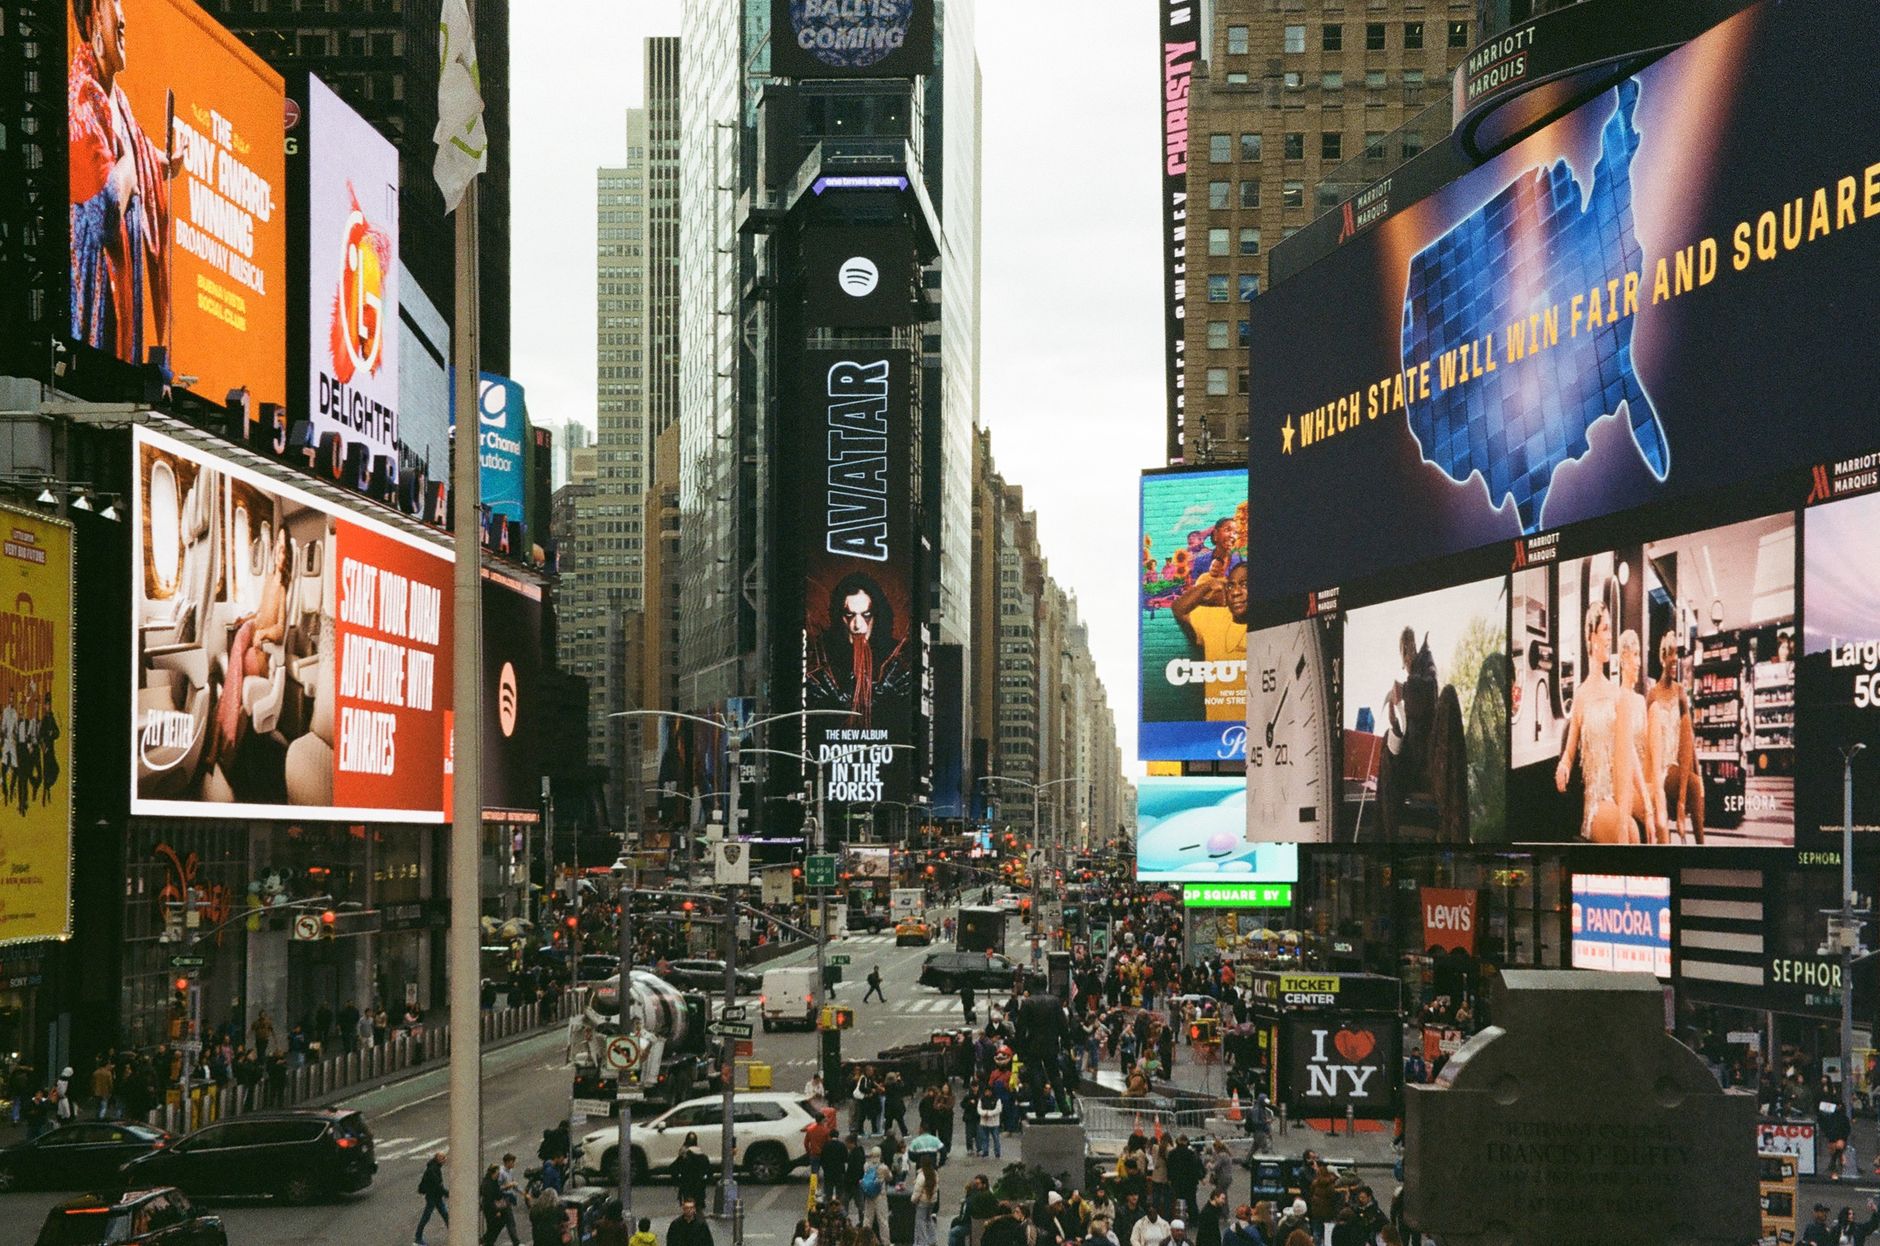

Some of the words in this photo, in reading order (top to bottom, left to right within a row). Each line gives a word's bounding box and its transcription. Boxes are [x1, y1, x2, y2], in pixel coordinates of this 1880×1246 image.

[799, 26, 904, 49] COMING
[1469, 26, 1536, 75] MARRIOTT
[1469, 57, 1525, 100] MARQUIS
[1165, 40, 1196, 176] CHRISTY
[210, 109, 233, 151] THE
[173, 115, 216, 187] TONY
[844, 177, 867, 185] times
[868, 178, 899, 187] square
[1357, 178, 1392, 209] MARRIOTT
[189, 176, 254, 259] WINNING
[1357, 199, 1388, 227] MARQUIS
[176, 218, 230, 274] BROADWAY
[229, 252, 267, 296] MUSICAL
[1300, 392, 1361, 447] WHICH
[1368, 366, 1431, 420] STATE
[1439, 334, 1497, 390] WILL
[1506, 305, 1559, 364] WIN
[1570, 272, 1640, 337] FAIR
[1652, 237, 1718, 305] AND
[1733, 162, 1880, 271] SQUARE
[238, 388, 343, 480] 1540
[487, 431, 521, 456] Channel
[827, 359, 890, 561] AVATAR
[1834, 472, 1878, 493] MARQUIS
[1528, 532, 1560, 549] MARRIOTT
[1528, 547, 1556, 562] MARQUIS
[340, 557, 377, 629] START
[378, 569, 408, 637] YOUR
[409, 580, 441, 646] DUBAI
[1318, 587, 1340, 600] MARRIOTT
[1318, 600, 1337, 611] MARQUIS
[340, 632, 405, 707] ADVENTURE
[407, 648, 434, 711] WITH
[1204, 698, 1225, 706] NOW
[146, 709, 164, 746] FLY
[163, 710, 194, 749] BETTER
[339, 707, 396, 776] EMIRATES
[825, 729, 840, 740] THE
[841, 729, 860, 740] NEW
[861, 729, 888, 740] ALBUM
[819, 744, 867, 764] DON'T
[869, 744, 893, 764] GO
[832, 762, 848, 782] IN
[851, 762, 881, 782] THE
[828, 781, 884, 801] FOREST
[1724, 795, 1777, 813] SEPHORA
[1798, 852, 1841, 865] SEPHORA
[1203, 889, 1257, 901] SQUARE
[1263, 889, 1280, 901] BY
[1285, 979, 1335, 991] TICKET
[1773, 959, 1852, 988] SEPHOR
[1284, 993, 1335, 1004] CENTER
[1311, 1029, 1328, 1062] I
[1306, 1064, 1377, 1097] NY
